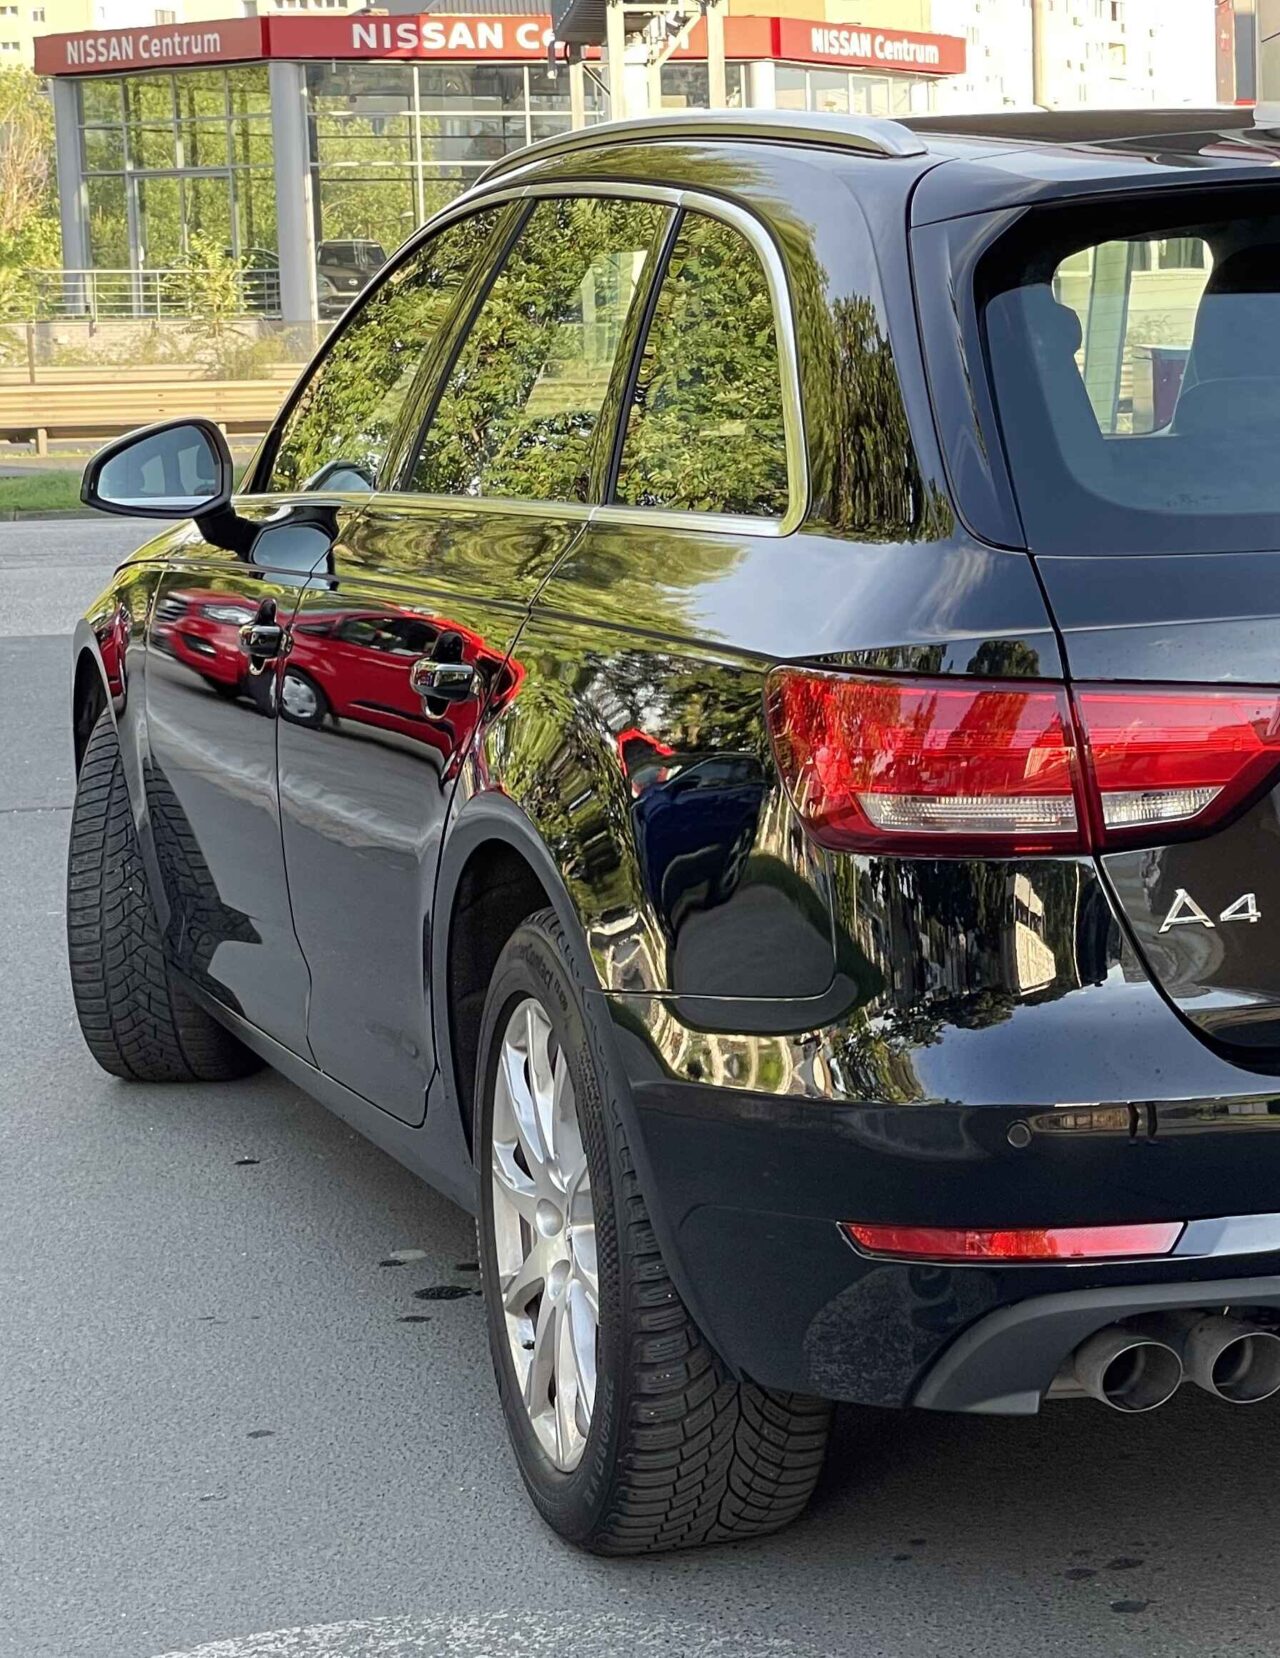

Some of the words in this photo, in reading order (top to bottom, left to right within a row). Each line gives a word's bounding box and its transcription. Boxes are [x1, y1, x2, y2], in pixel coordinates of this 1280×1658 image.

[66, 35, 133, 65] NISSAN
[139, 32, 221, 58] Centrum
[352, 22, 504, 49] NISSAN
[810, 27, 872, 58] NISSAN
[874, 35, 940, 64] Centrum
[1158, 888, 1262, 934] A4
